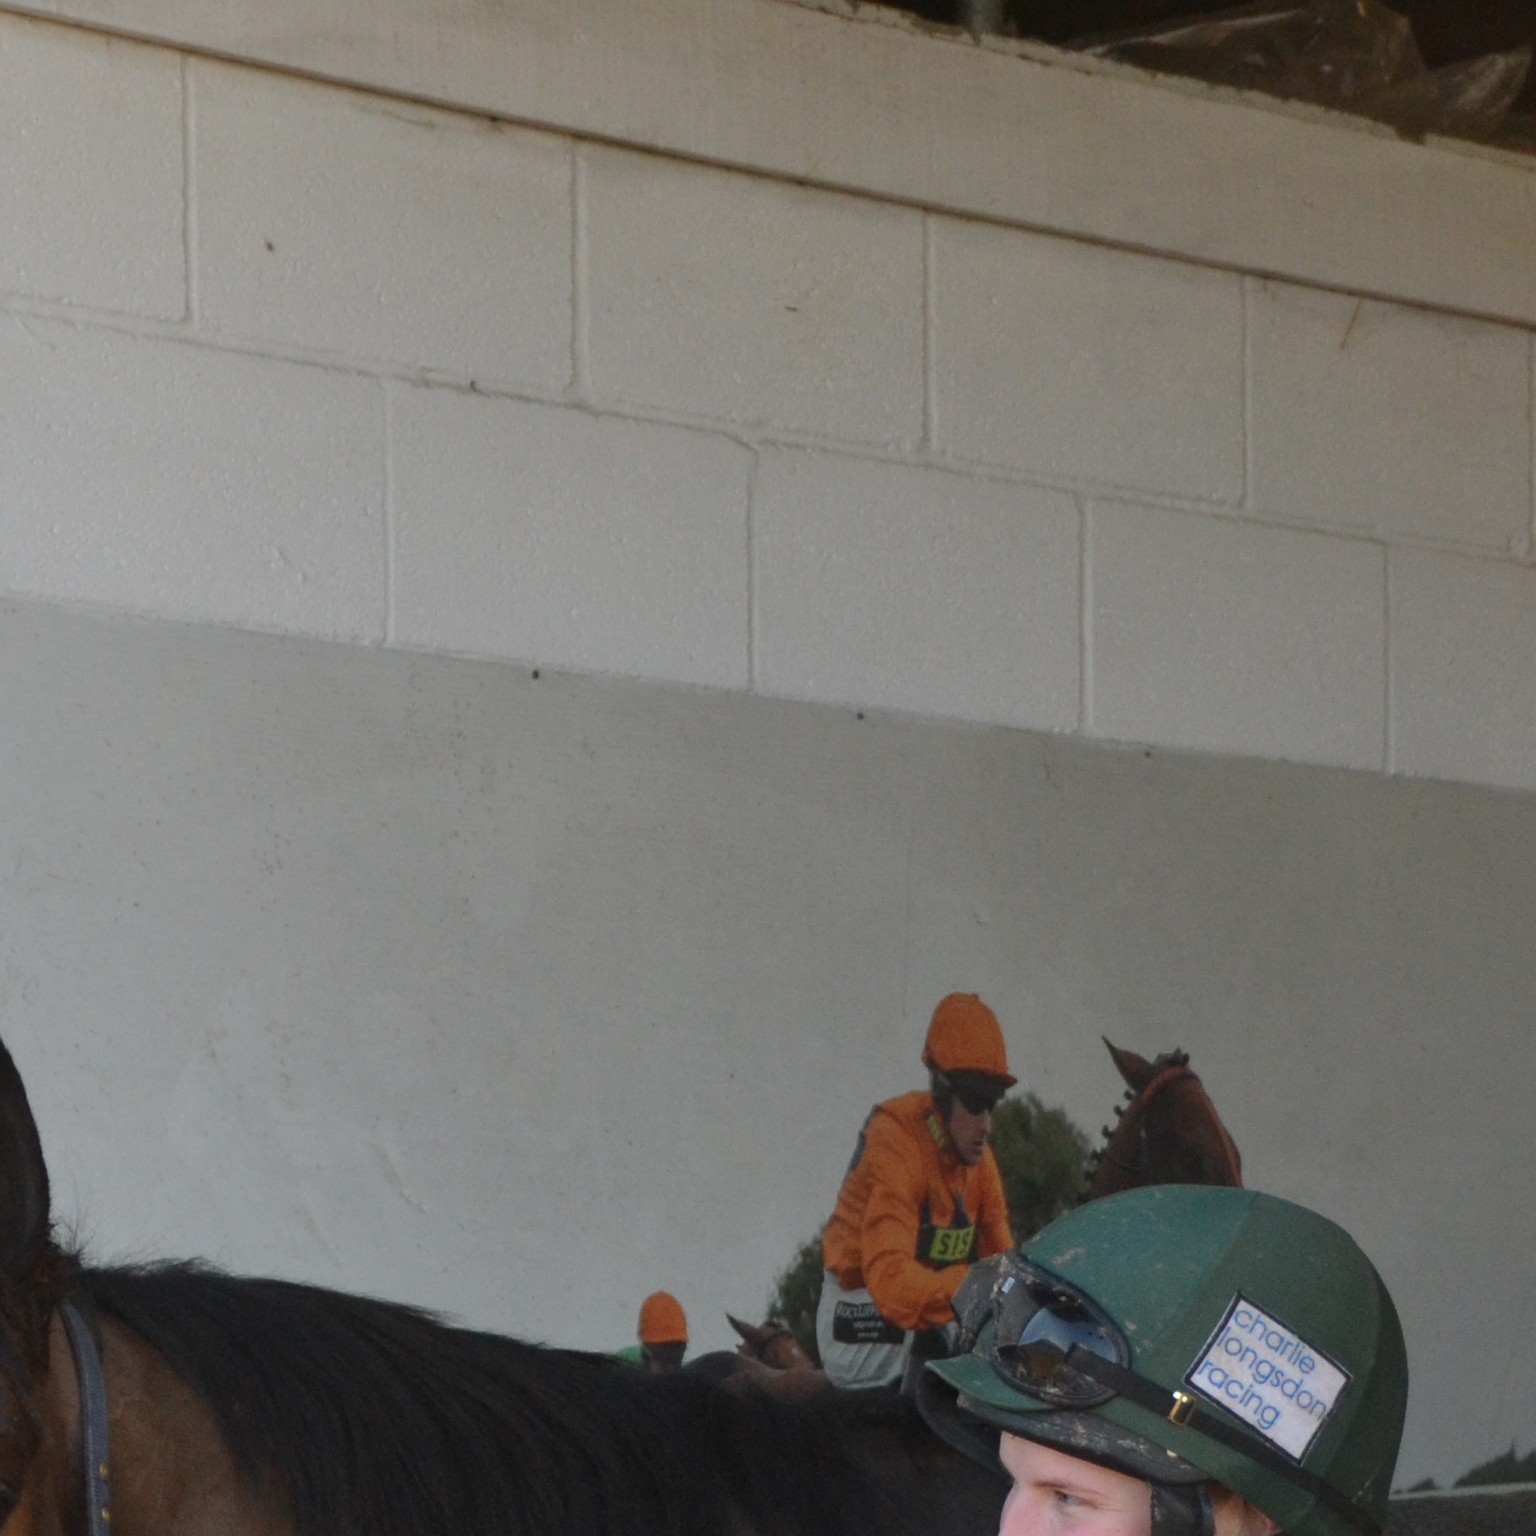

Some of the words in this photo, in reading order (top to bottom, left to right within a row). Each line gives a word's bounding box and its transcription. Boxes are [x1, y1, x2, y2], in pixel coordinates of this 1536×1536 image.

[1216, 1327, 1327, 1421] longsdon
[1234, 1309, 1315, 1374] charlie
[1198, 1359, 1280, 1429] racing
